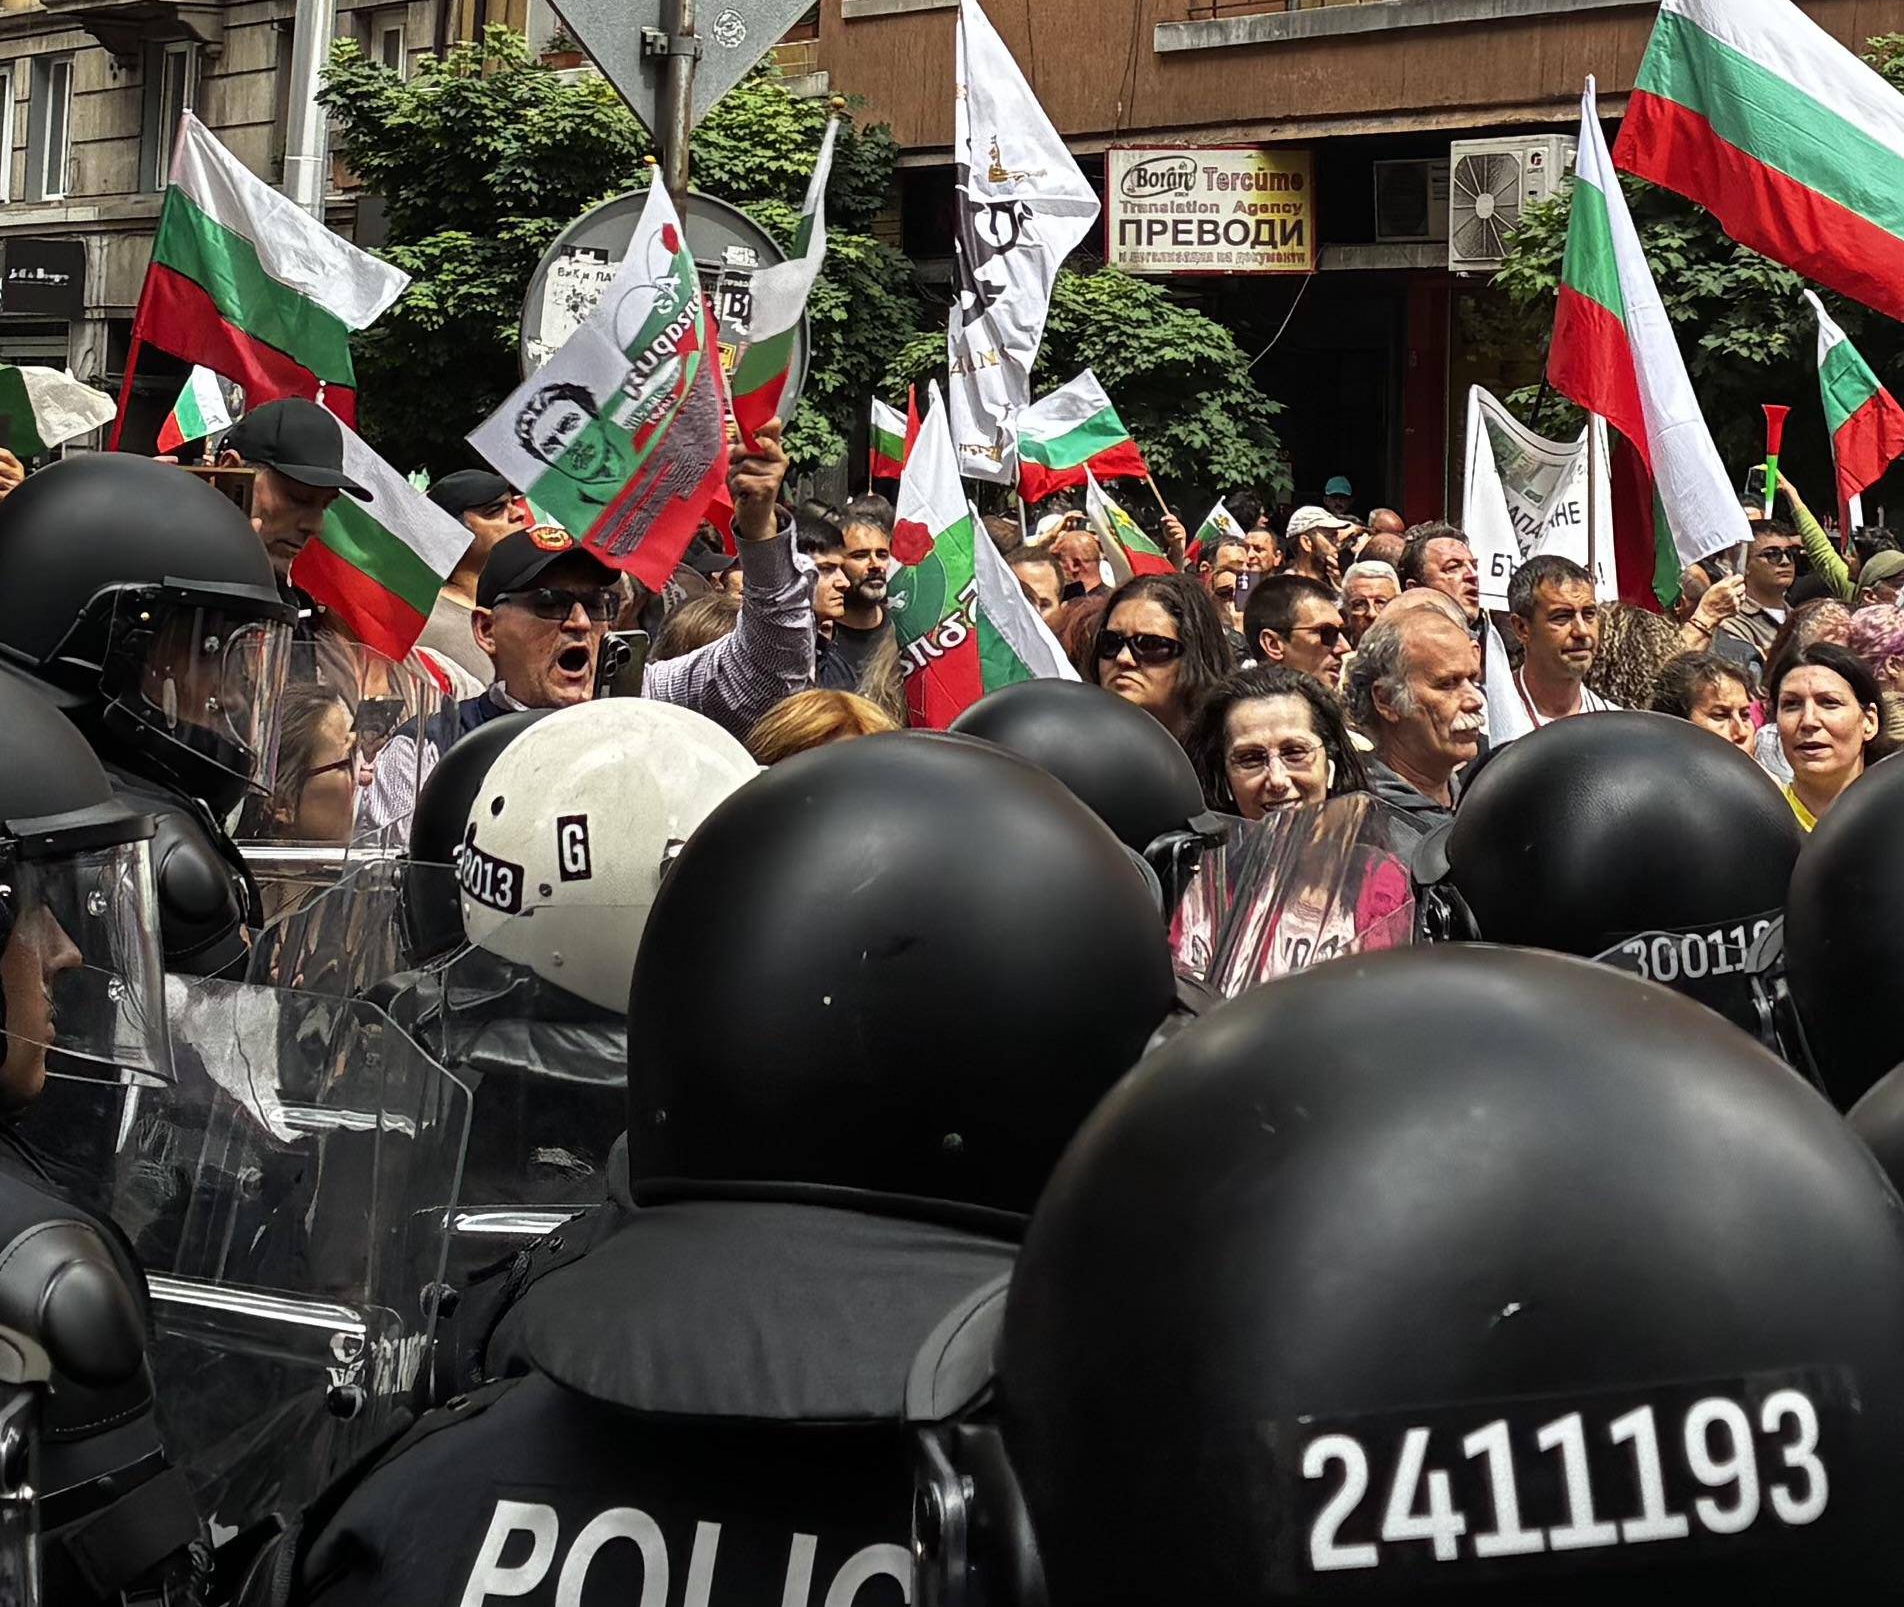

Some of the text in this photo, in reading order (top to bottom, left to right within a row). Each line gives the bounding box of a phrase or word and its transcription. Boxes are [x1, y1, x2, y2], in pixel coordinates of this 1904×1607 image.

[1120, 200, 1302, 216] Translation Agency
[1119, 219, 1303, 249] ПРЕВОДИ
[562, 824, 586, 872] G
[1622, 920, 1770, 982] 30011
[1303, 1388, 1829, 1571] 2411193
